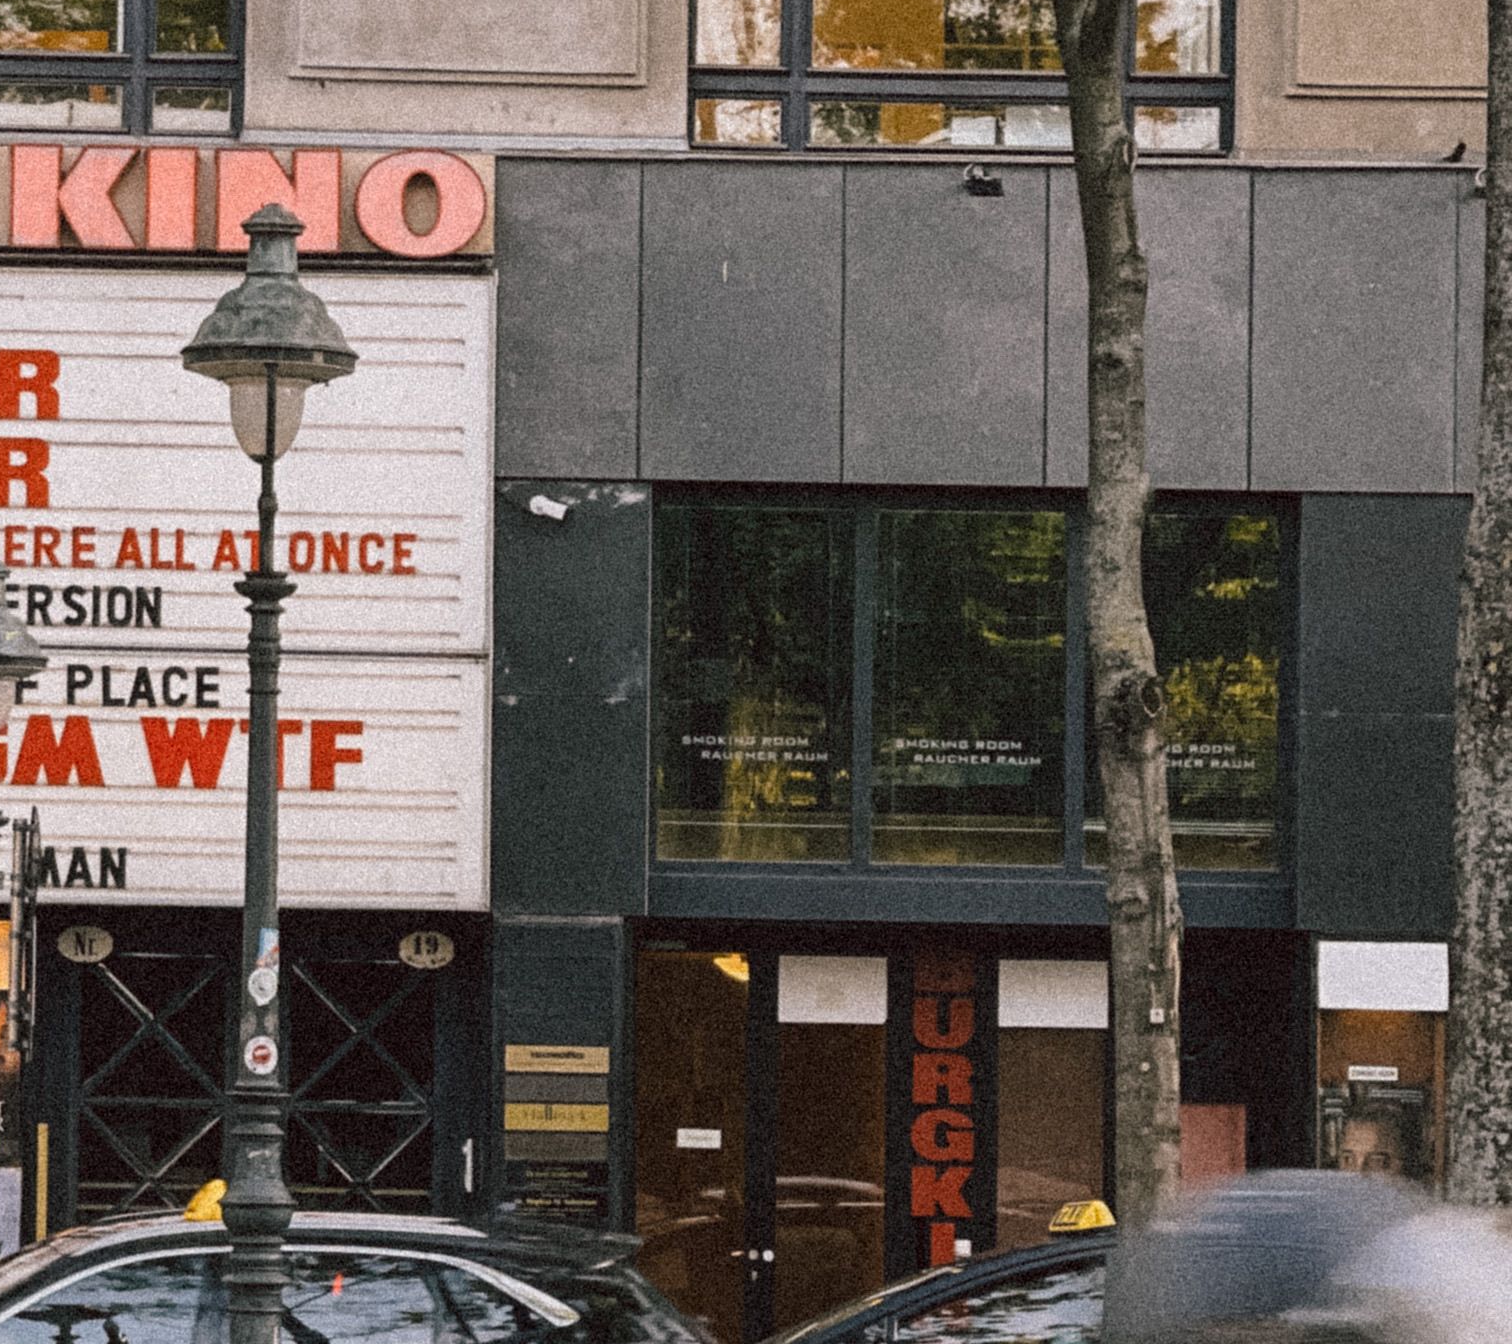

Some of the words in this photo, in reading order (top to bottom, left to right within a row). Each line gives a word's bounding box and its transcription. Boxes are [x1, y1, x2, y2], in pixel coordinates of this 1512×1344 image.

[10, 142, 487, 258] KINO
[116, 527, 196, 571] ALL
[213, 530, 260, 572] AT
[289, 532, 418, 575] ONCE
[67, 665, 219, 708] PLACE
[761, 736, 810, 747] ROOM
[894, 738, 970, 750] SMOKING
[975, 739, 1023, 751] ROOM
[913, 754, 991, 765] RAUCHER
[37, 847, 127, 889] MAN
[414, 935, 439, 955] 19
